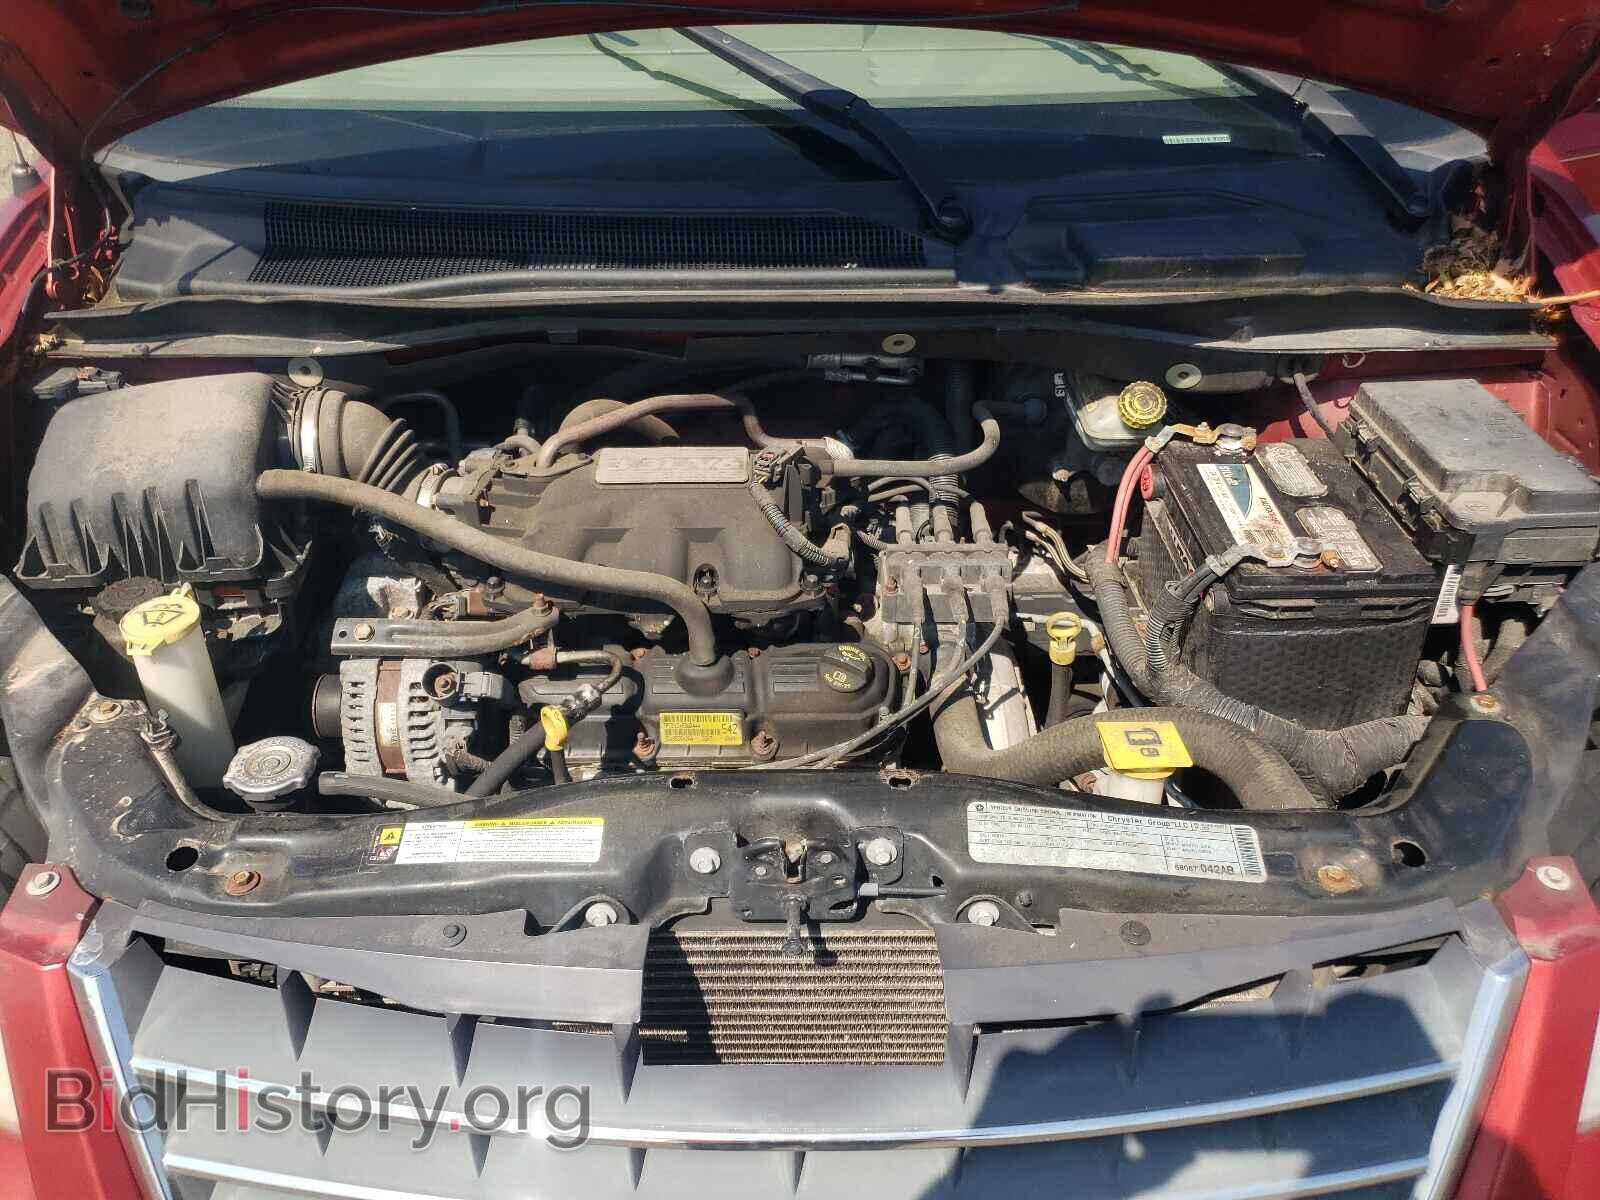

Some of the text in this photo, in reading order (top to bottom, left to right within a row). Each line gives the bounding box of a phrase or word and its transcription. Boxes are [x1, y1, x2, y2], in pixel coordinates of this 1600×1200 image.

[721, 723, 738, 735] 542
[1107, 814, 1143, 825] Chrysler
[1147, 819, 1170, 828] Group
